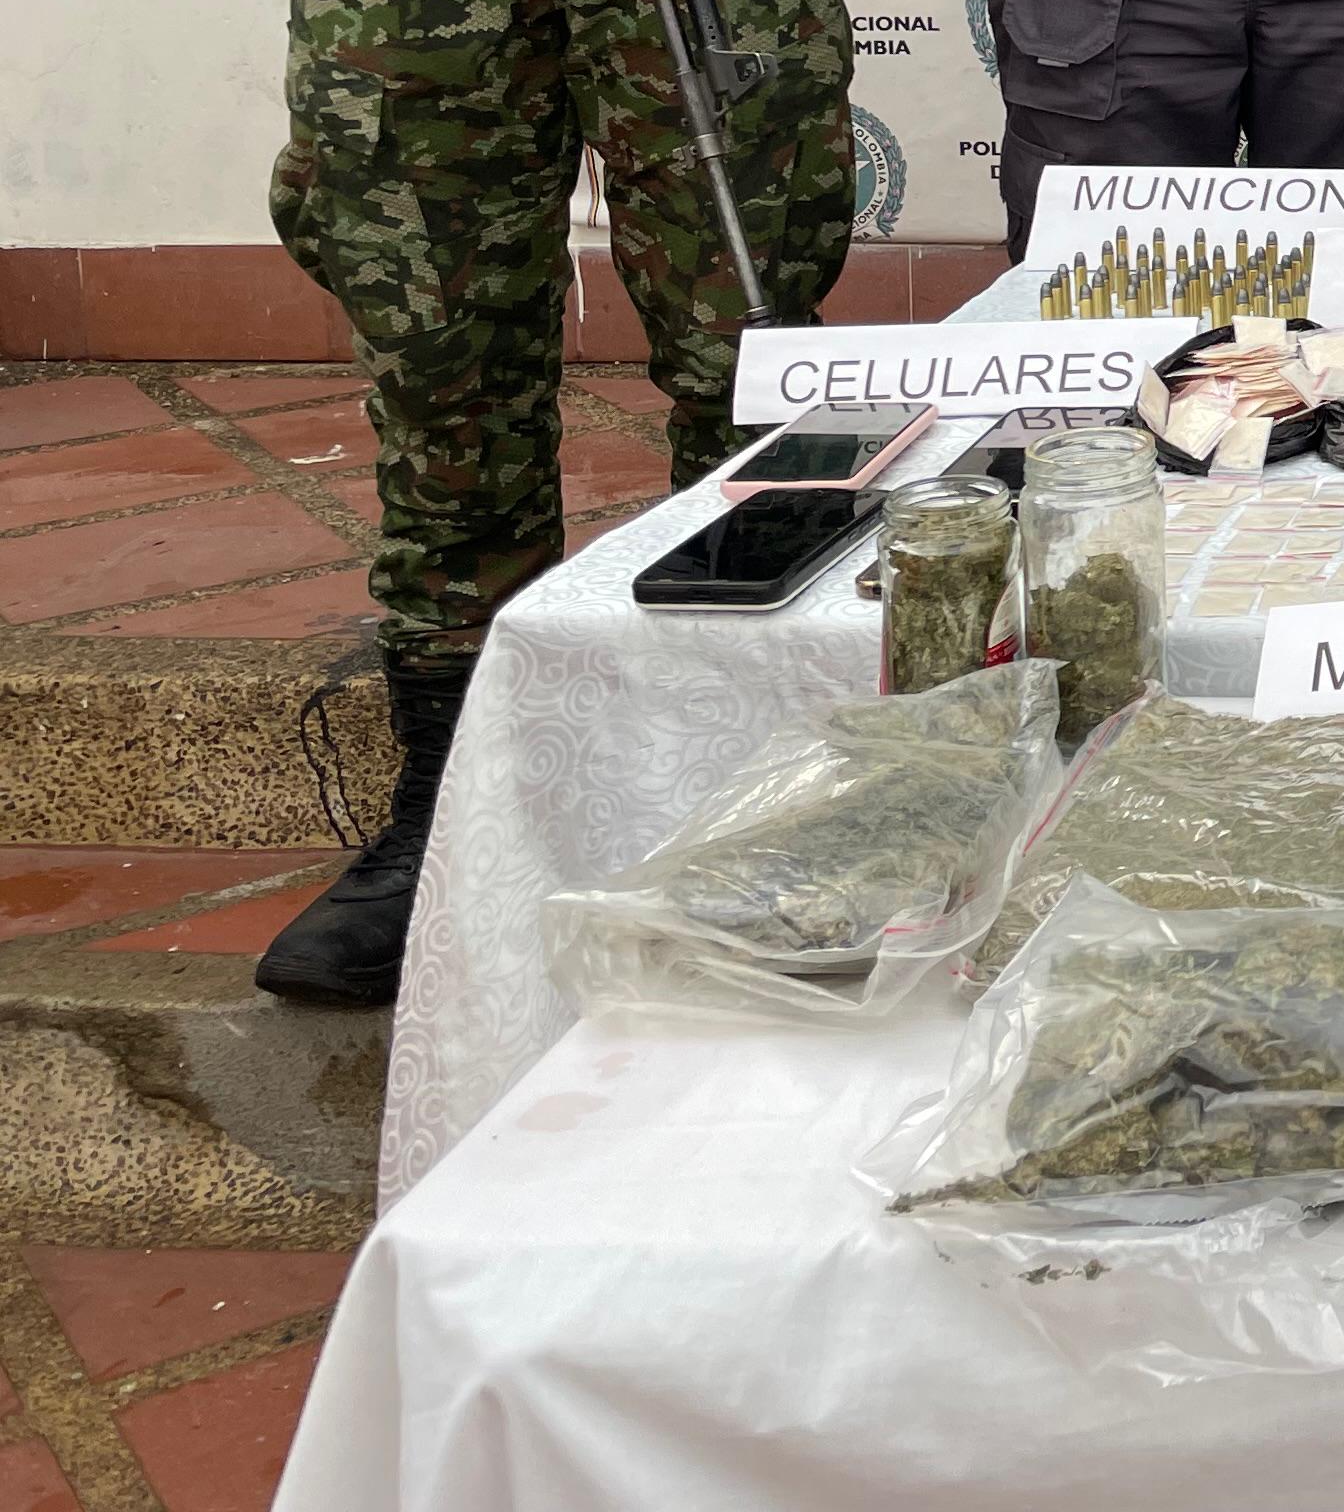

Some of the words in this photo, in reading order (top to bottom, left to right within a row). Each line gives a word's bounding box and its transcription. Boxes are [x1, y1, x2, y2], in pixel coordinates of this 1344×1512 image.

[852, 15, 939, 32] CIONAL
[854, 40, 911, 55] MBIA
[855, 127, 886, 185] OLOMBIA
[779, 351, 1135, 405] CELULARES
